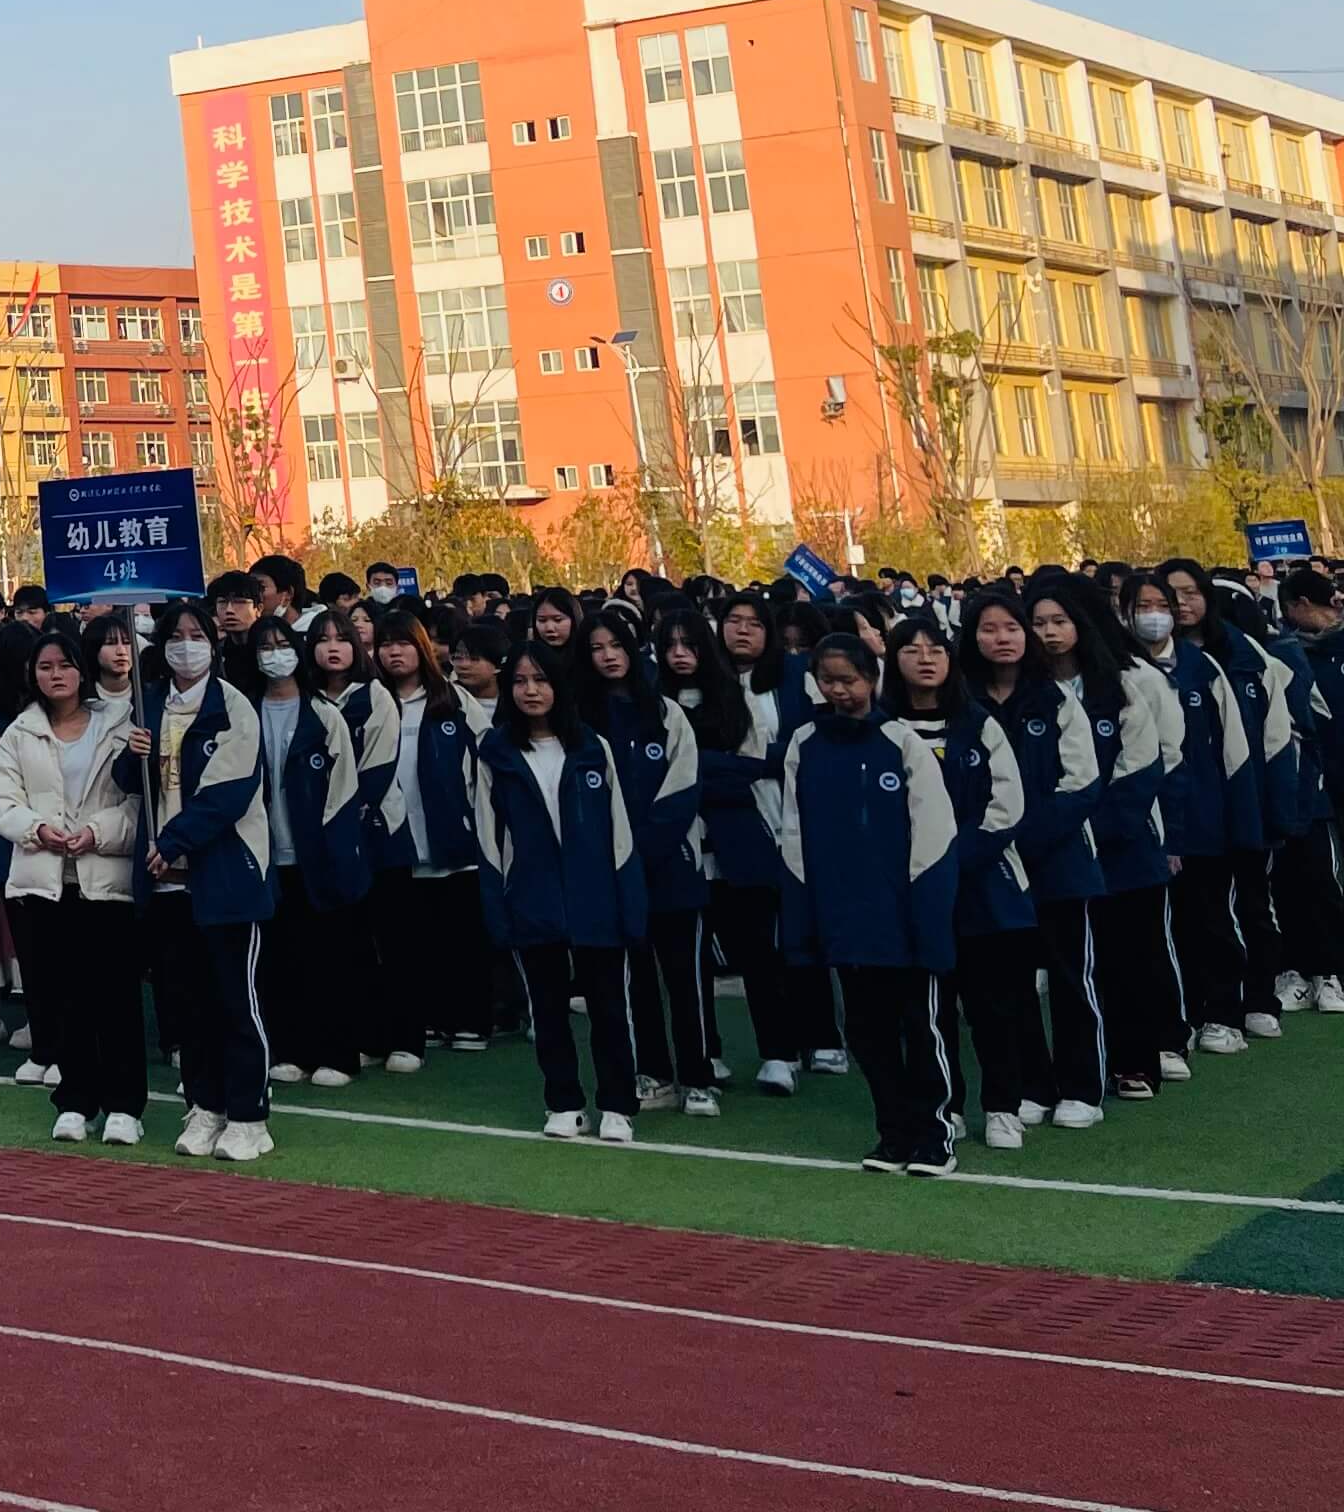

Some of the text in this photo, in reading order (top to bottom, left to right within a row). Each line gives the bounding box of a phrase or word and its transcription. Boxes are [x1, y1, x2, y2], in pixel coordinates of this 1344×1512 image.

[66, 515, 170, 551] 幼儿教育
[103, 559, 139, 582] 4班
